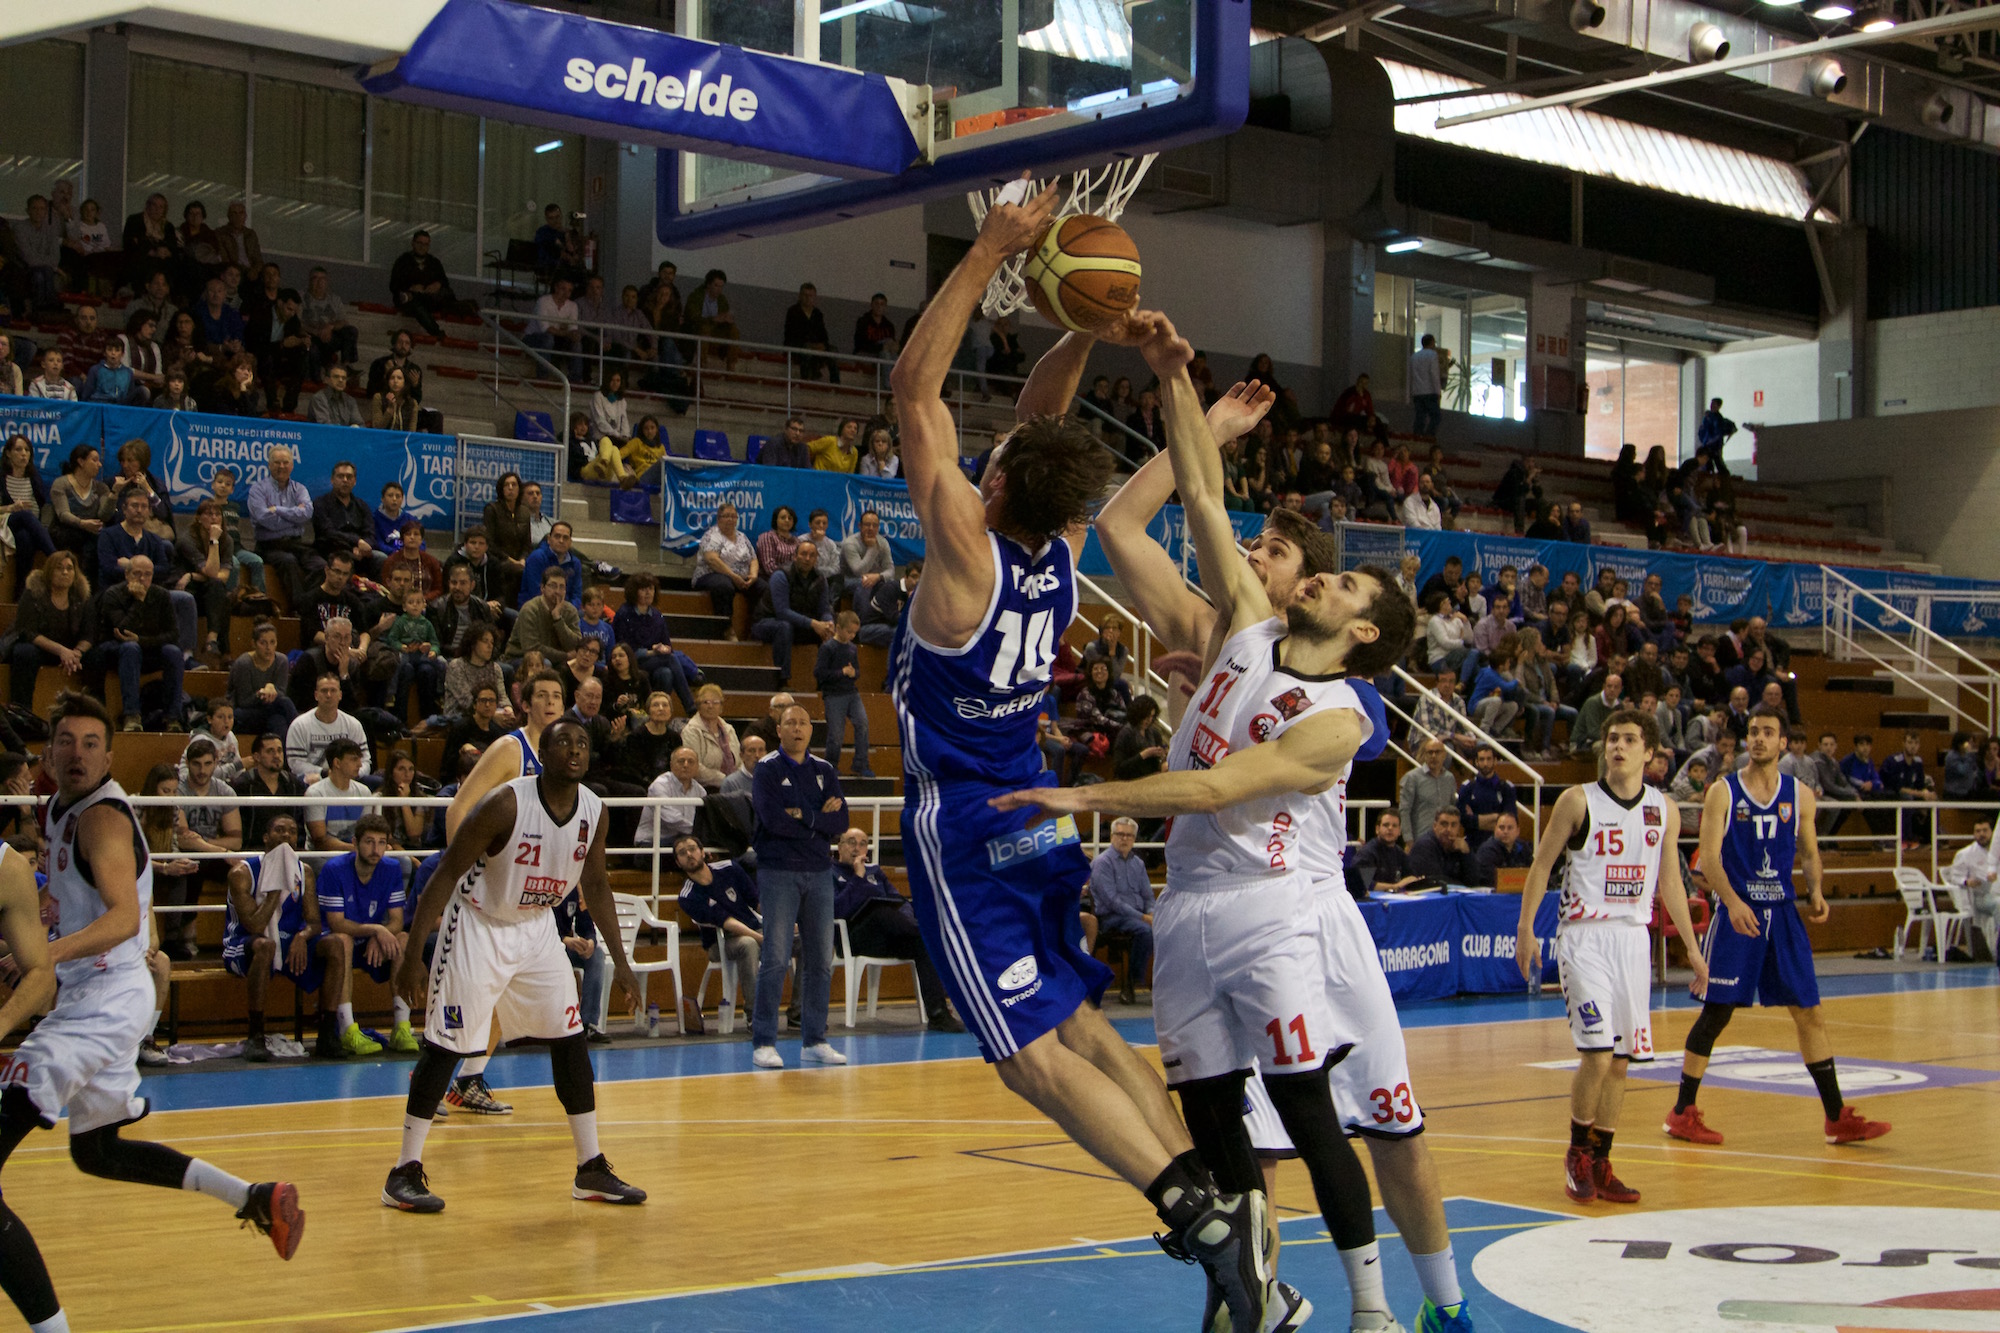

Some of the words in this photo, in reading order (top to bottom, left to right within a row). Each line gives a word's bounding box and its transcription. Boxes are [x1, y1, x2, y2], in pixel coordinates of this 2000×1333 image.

[564, 57, 758, 121] schelde
[189, 423, 210, 434] XVIII
[212, 427, 235, 436] JOCS
[237, 428, 302, 440] MEDITERRANIS
[422, 443, 441, 452] XVIII
[443, 445, 457, 453] JOC
[678, 490, 764, 510] TARRAGONA
[989, 607, 1057, 693] 14
[1199, 671, 1239, 719] 11
[1752, 814, 1778, 840] 17
[514, 842, 541, 867] 21
[1594, 829, 1624, 856] 15
[1768, 892, 1785, 901] 2017
[1379, 940, 1450, 973] TARRAGONA
[1462, 934, 1490, 958] CLUB
[1265, 1013, 1316, 1066] 11
[1369, 1082, 1414, 1124] 33
